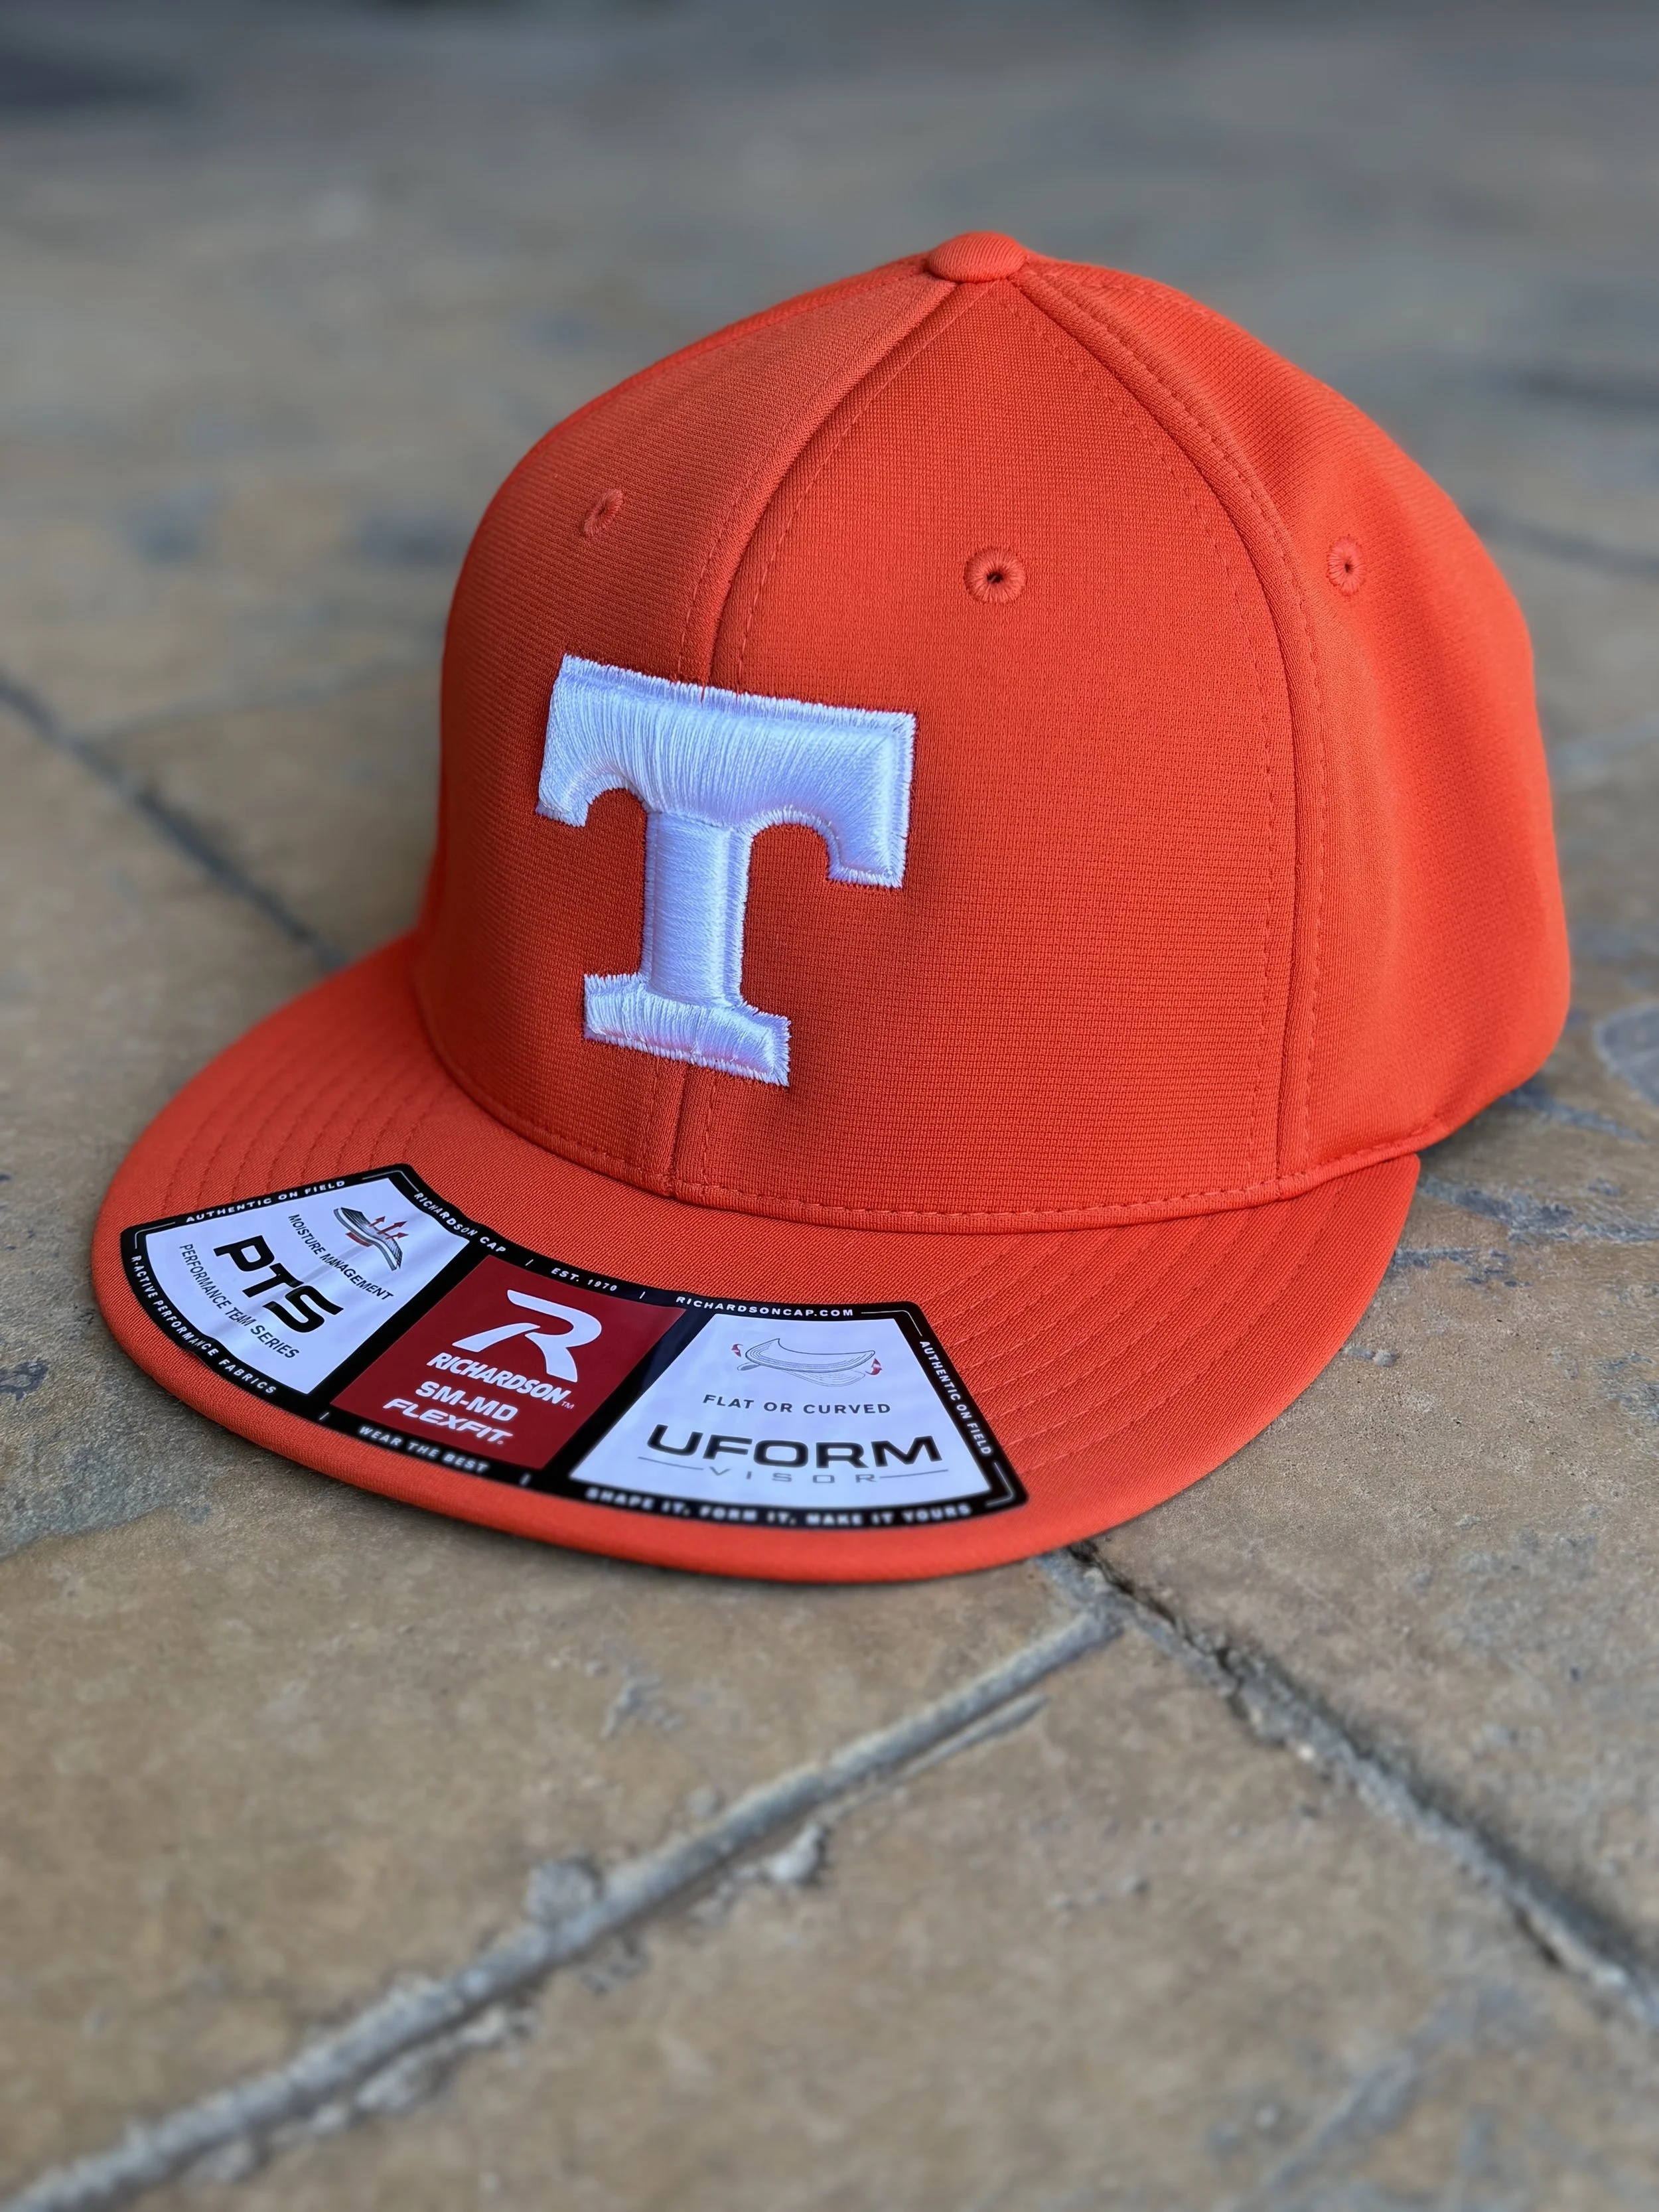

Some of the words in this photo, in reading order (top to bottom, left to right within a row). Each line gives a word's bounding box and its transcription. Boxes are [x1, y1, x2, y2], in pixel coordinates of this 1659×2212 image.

[535, 652, 917, 1087] T
[186, 1197, 272, 1223] AUTHENTIC
[278, 1191, 299, 1202] ON
[305, 1180, 346, 1195] FIELD
[414, 1193, 477, 1238] RICHARDSON
[480, 1236, 506, 1253] CAP
[287, 1214, 326, 1256] MOISTURE
[319, 1252, 395, 1301] MANAGEMENT
[551, 1268, 580, 1282] EST.
[587, 1279, 618, 1291] 1970
[179, 1243, 232, 1310] PERFORMANCE
[225, 1306, 253, 1327] TEAM
[250, 1325, 300, 1360] SERIES
[213, 1234, 344, 1334] PTS
[676, 1295, 855, 1317] RICHARDSONCAP.COM
[153, 1299, 219, 1357] PERFORMANCE
[218, 1356, 277, 1394] FABRICS
[415, 1380, 518, 1422] SM-MD
[703, 1394, 754, 1410] FLAT
[763, 1402, 792, 1413] OR
[803, 1403, 891, 1415] CURVED
[920, 1341, 960, 1401] AUTHENTIC
[957, 1404, 972, 1419] ON
[967, 1422, 991, 1454] FIELD
[359, 1426, 402, 1447] WEAR
[408, 1441, 439, 1458] THE
[444, 1452, 490, 1473] BEST
[646, 1424, 943, 1469] UFORM
[708, 1467, 877, 1484] VISOR
[585, 1487, 654, 1511] SHAPE
[699, 1505, 757, 1521] FORM
[806, 1512, 863, 1526] MAKE
[871, 1512, 894, 1525] IT
[901, 1503, 972, 1523] YOURS
